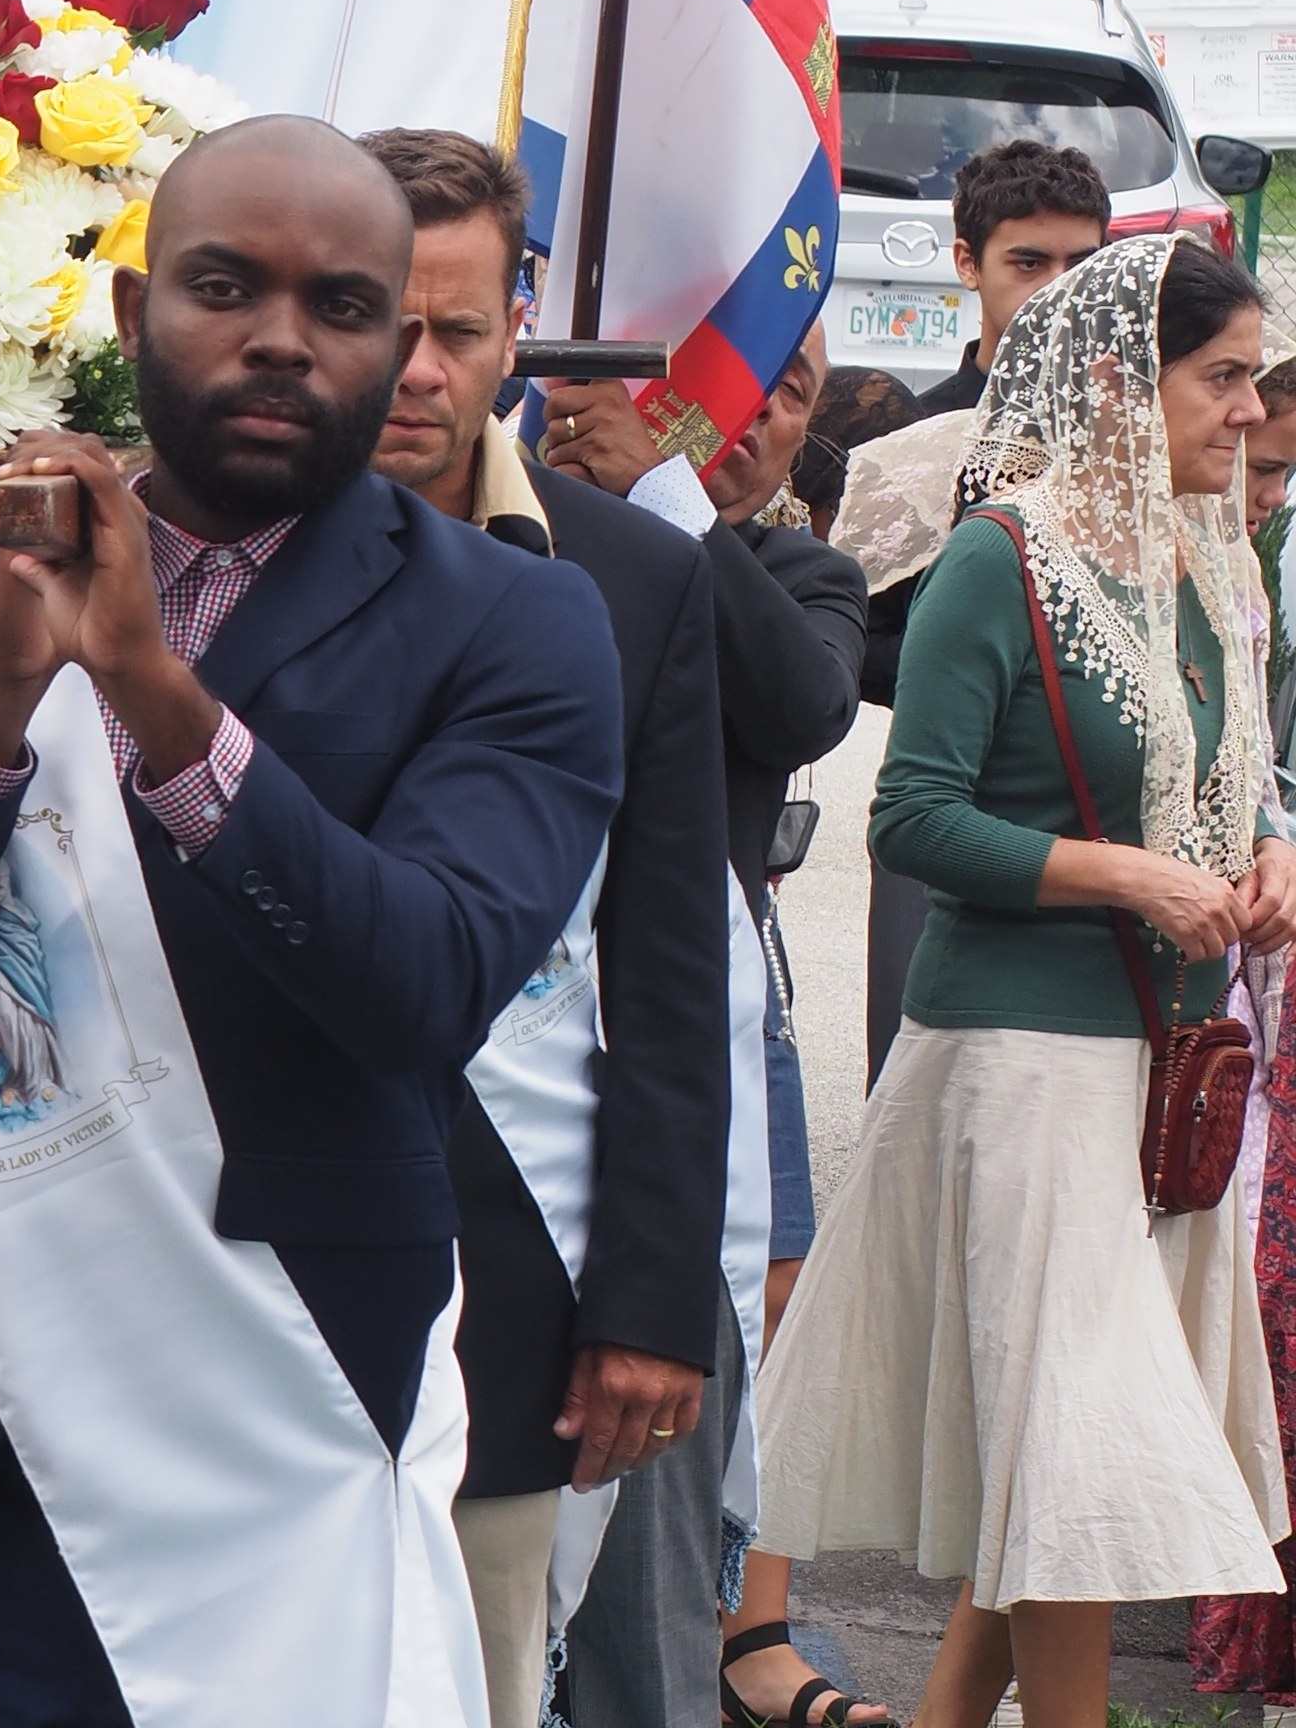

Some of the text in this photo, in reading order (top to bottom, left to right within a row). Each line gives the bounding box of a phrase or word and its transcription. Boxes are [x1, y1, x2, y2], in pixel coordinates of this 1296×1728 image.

[849, 306, 958, 338] GYM T94
[9, 1148, 43, 1170] LADY
[44, 1140, 63, 1157] OF
[63, 1111, 116, 1147] VICTORY
